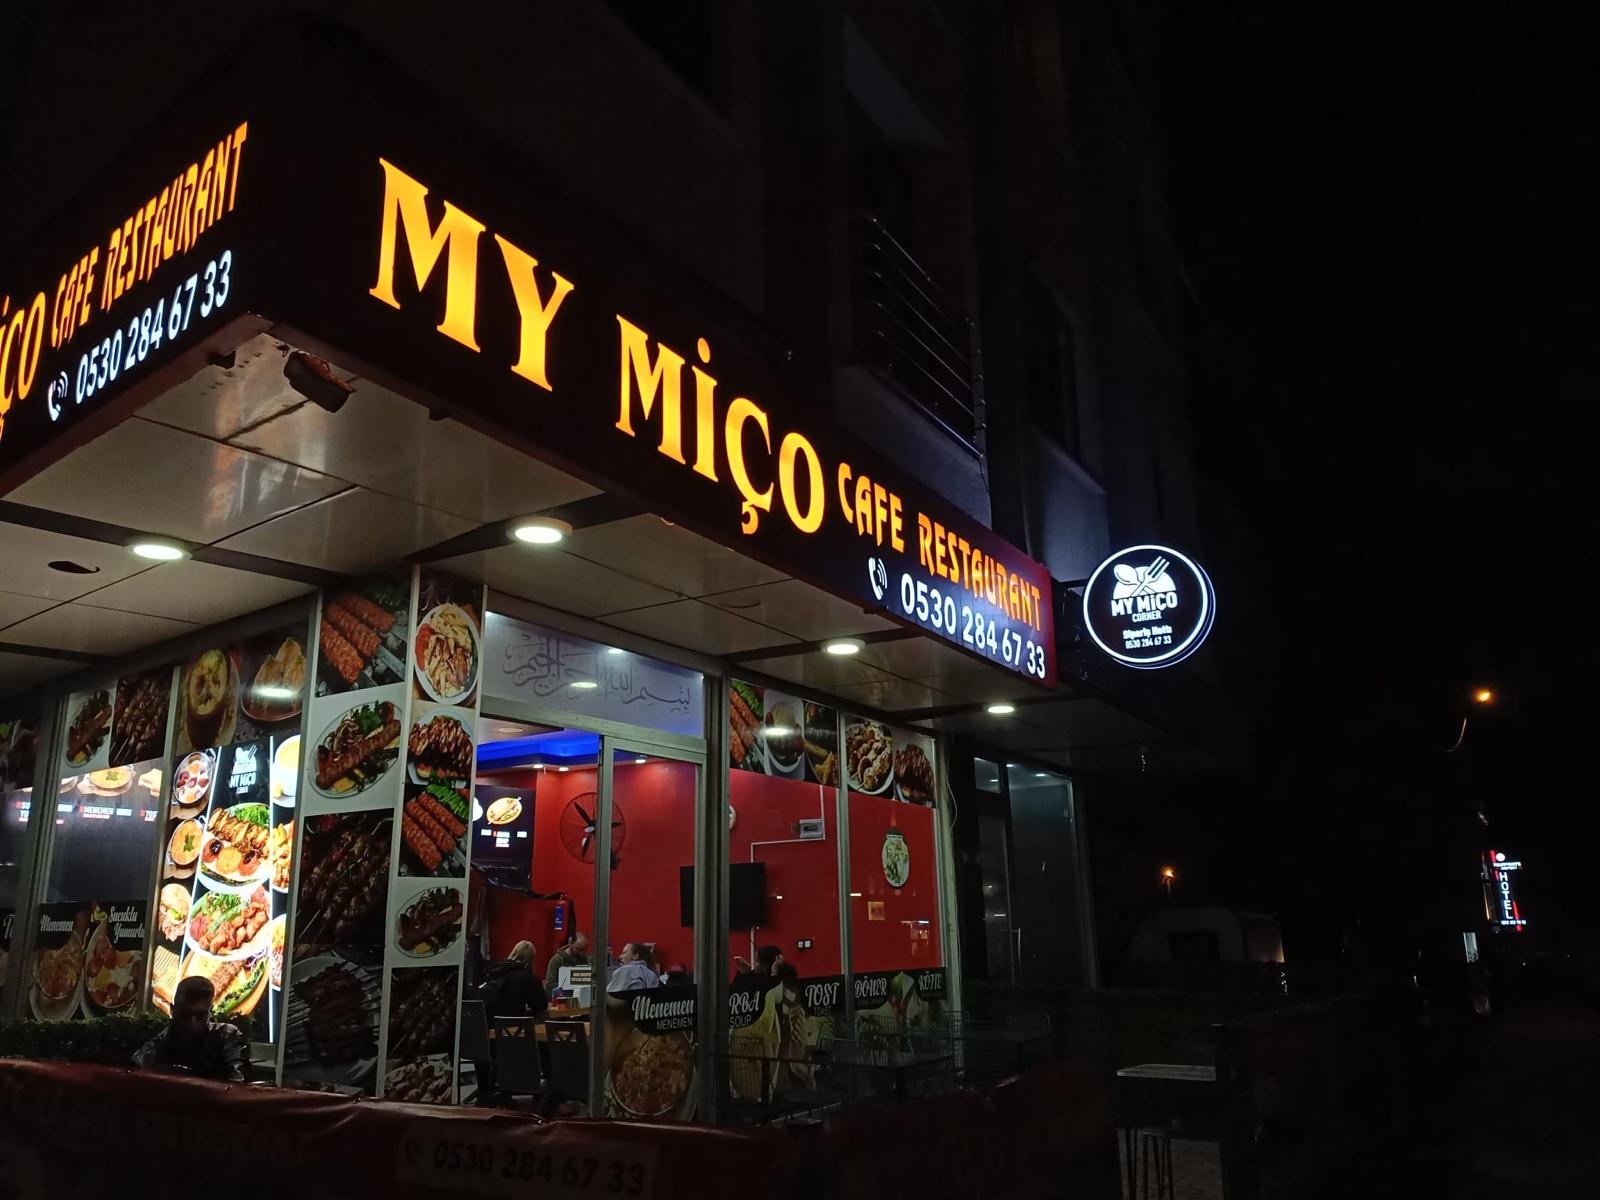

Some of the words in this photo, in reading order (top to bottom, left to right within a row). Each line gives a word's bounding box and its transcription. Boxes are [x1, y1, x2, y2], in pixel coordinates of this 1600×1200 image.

[51, 246, 99, 351] CAFE
[101, 121, 247, 314] RESTAURANT
[369, 157, 575, 392] MY
[75, 328, 122, 405] 0530
[124, 297, 164, 371] 284
[168, 273, 197, 340] 67
[200, 249, 232, 318] 33
[837, 462, 905, 553] CAFE
[918, 512, 1042, 632] RESTAURANT
[900, 573, 957, 635] 0530
[961, 605, 998, 654] 284
[1002, 628, 1022, 666] 67
[1026, 640, 1046, 679] 33
[1110, 597, 1134, 617] MY
[1131, 609, 1162, 623] CORNER
[1499, 871, 1514, 920] HOTEL
[632, 993, 695, 1021] Menemen
[804, 982, 840, 1008] TOST
[656, 1015, 694, 1031] MENEMEN
[729, 1014, 751, 1029] SOUP
